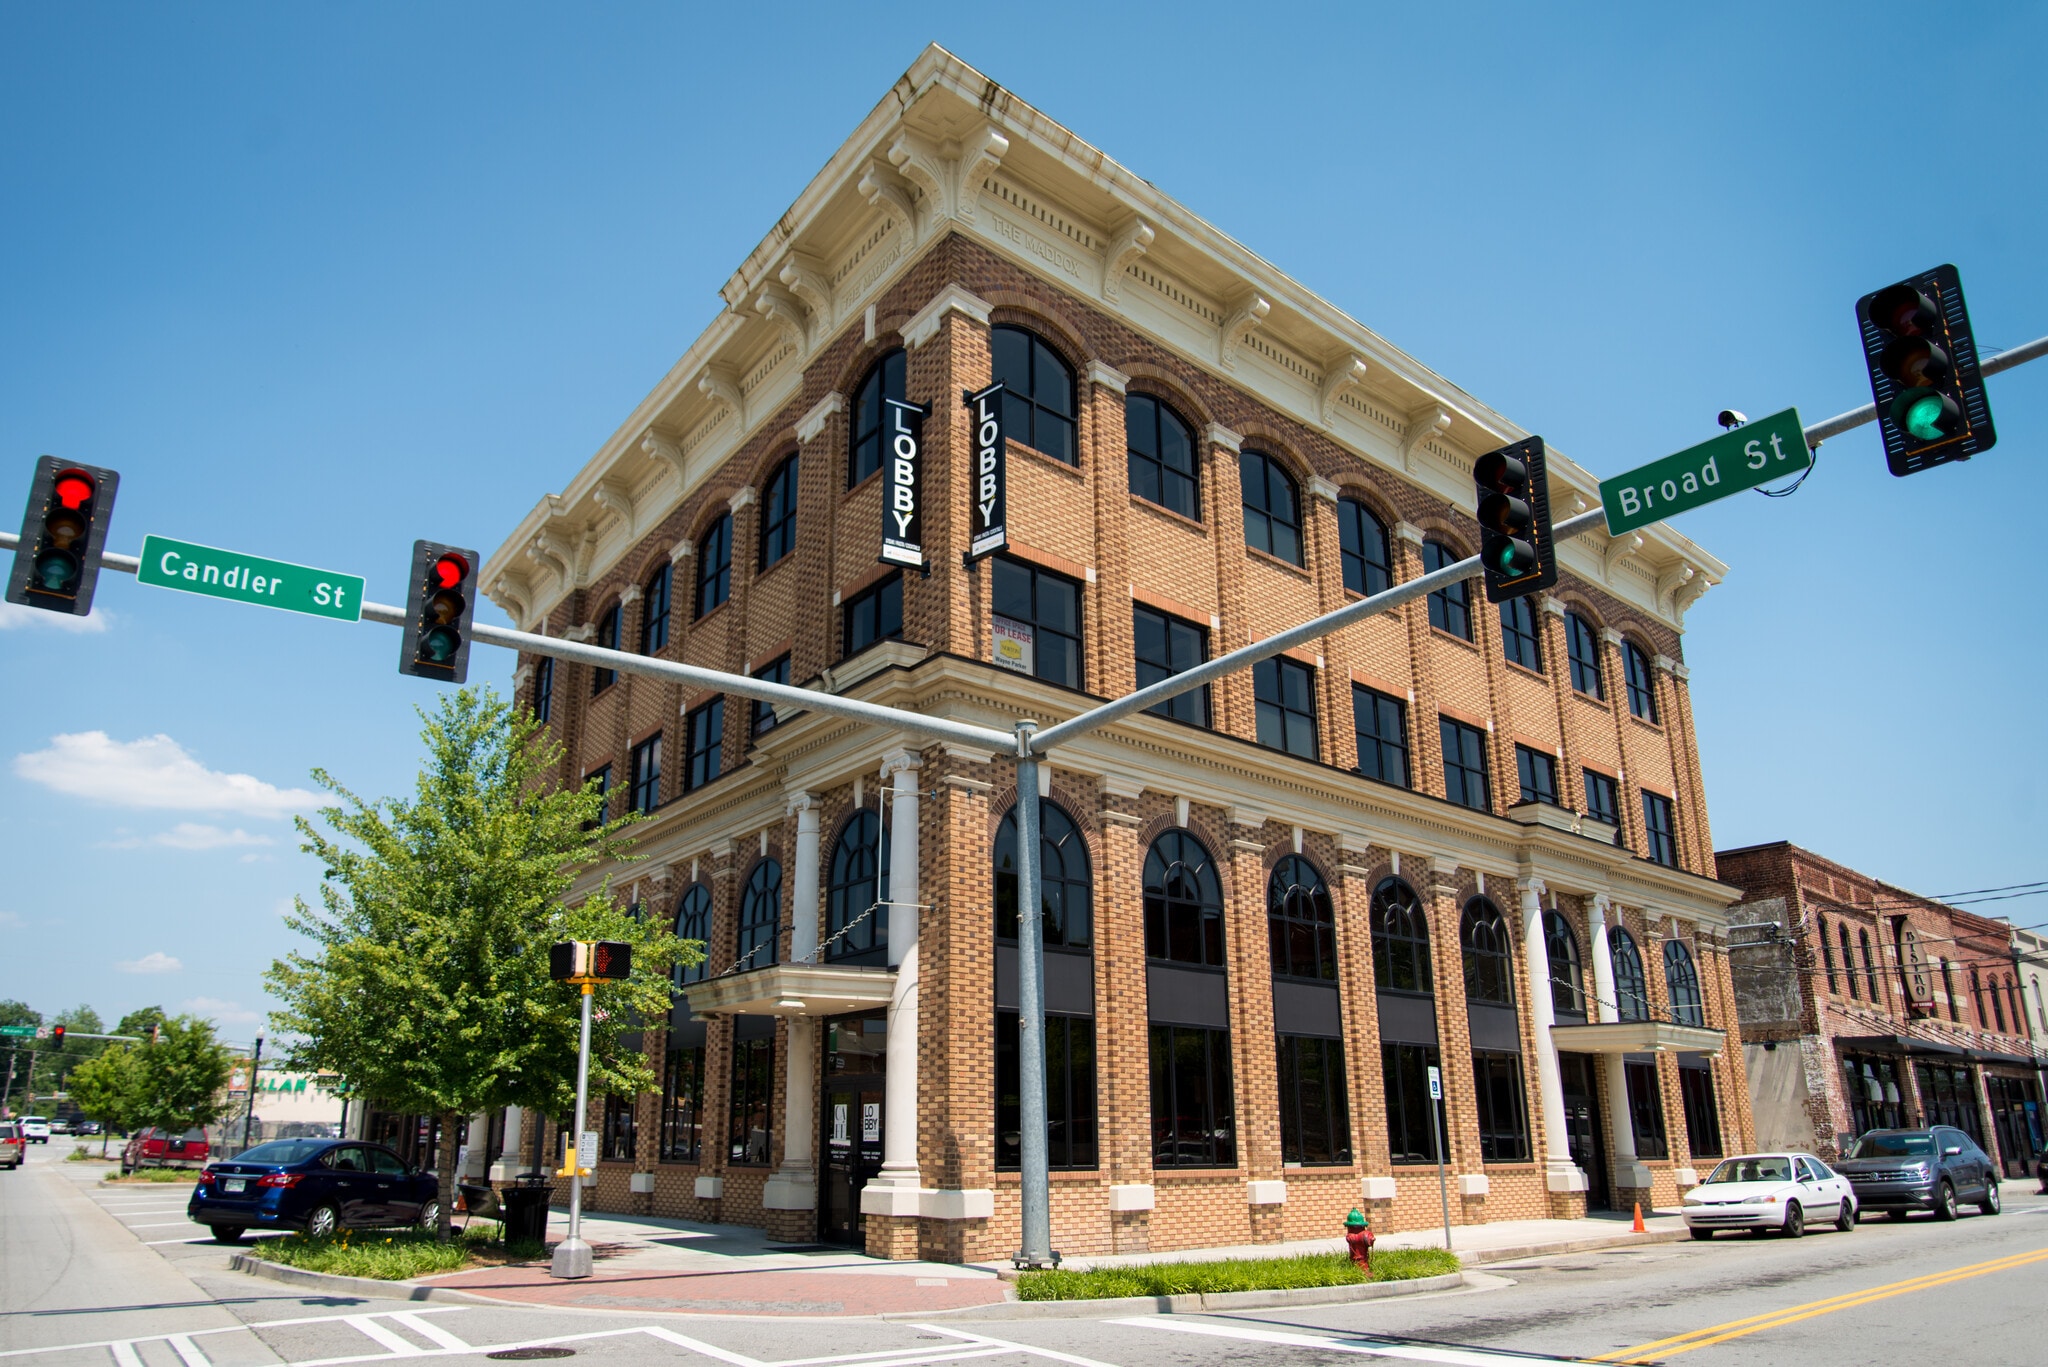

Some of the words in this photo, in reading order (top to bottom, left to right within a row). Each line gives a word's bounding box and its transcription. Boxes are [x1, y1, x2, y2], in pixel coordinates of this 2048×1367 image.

[863, 243, 901, 292] MADDOX
[992, 214, 1021, 244] THE
[1025, 234, 1080, 278] MADDOX
[892, 407, 917, 538] LOBBY
[979, 398, 998, 528] LOBBY
[1618, 455, 1720, 517] Broad
[1744, 432, 1786, 470] St
[160, 551, 282, 595] Candler
[313, 582, 345, 609] St
[1008, 628, 1031, 643] LEASE
